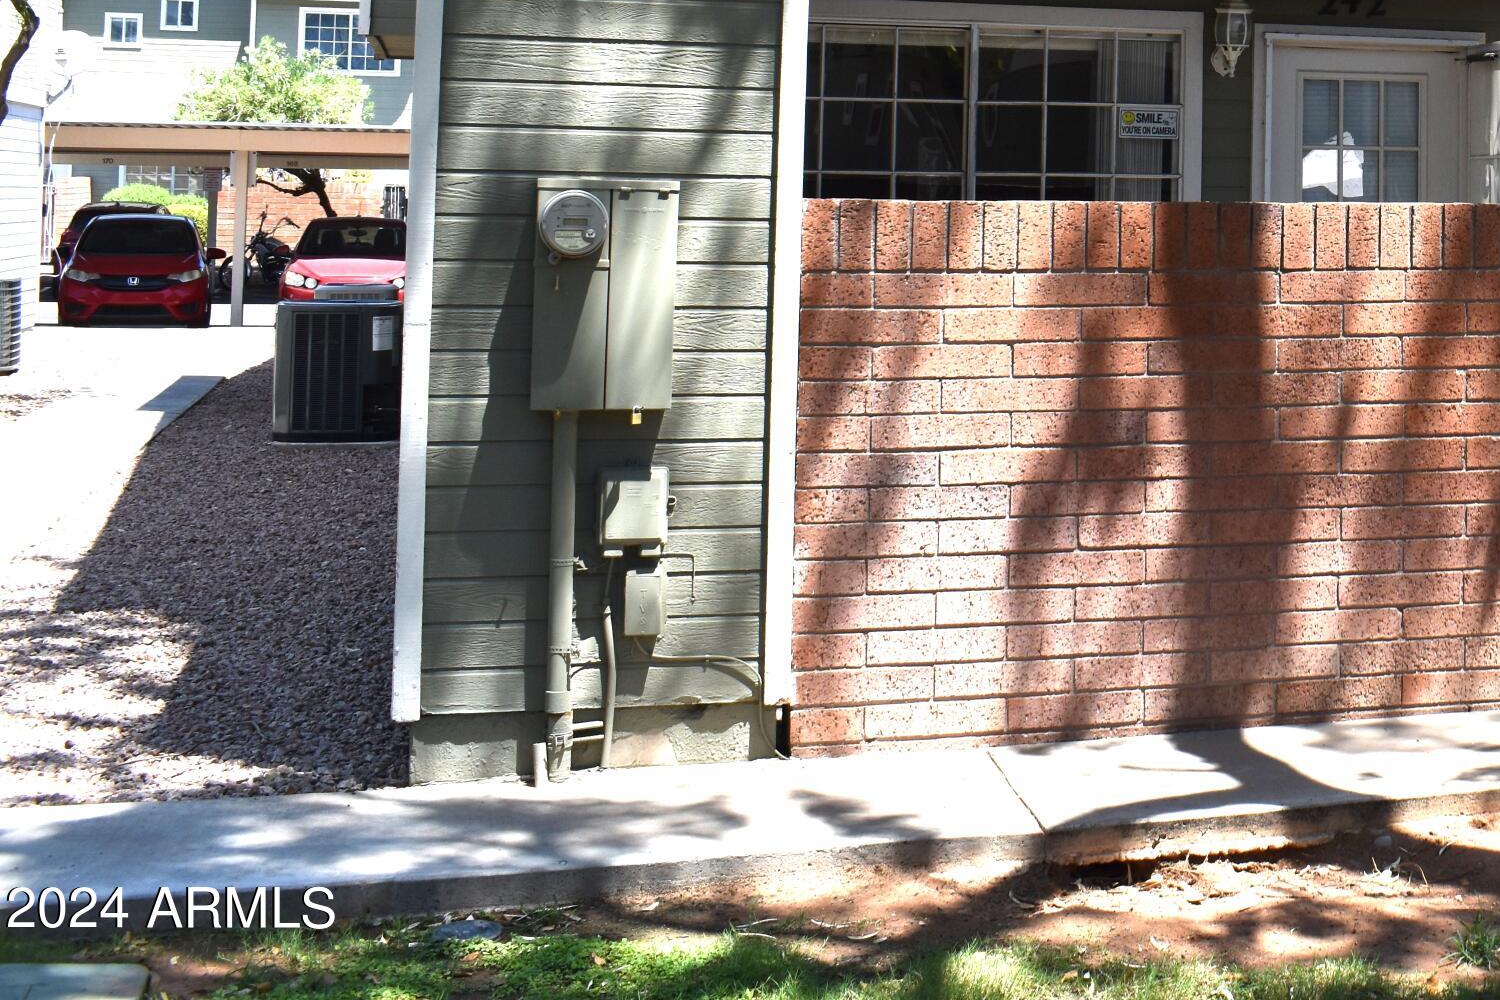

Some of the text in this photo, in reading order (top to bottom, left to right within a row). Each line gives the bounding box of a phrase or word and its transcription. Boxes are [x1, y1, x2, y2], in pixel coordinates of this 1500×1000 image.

[1136, 112, 1163, 124] SMILE
[1122, 126, 1176, 135] YOU'RE ON CAMERA
